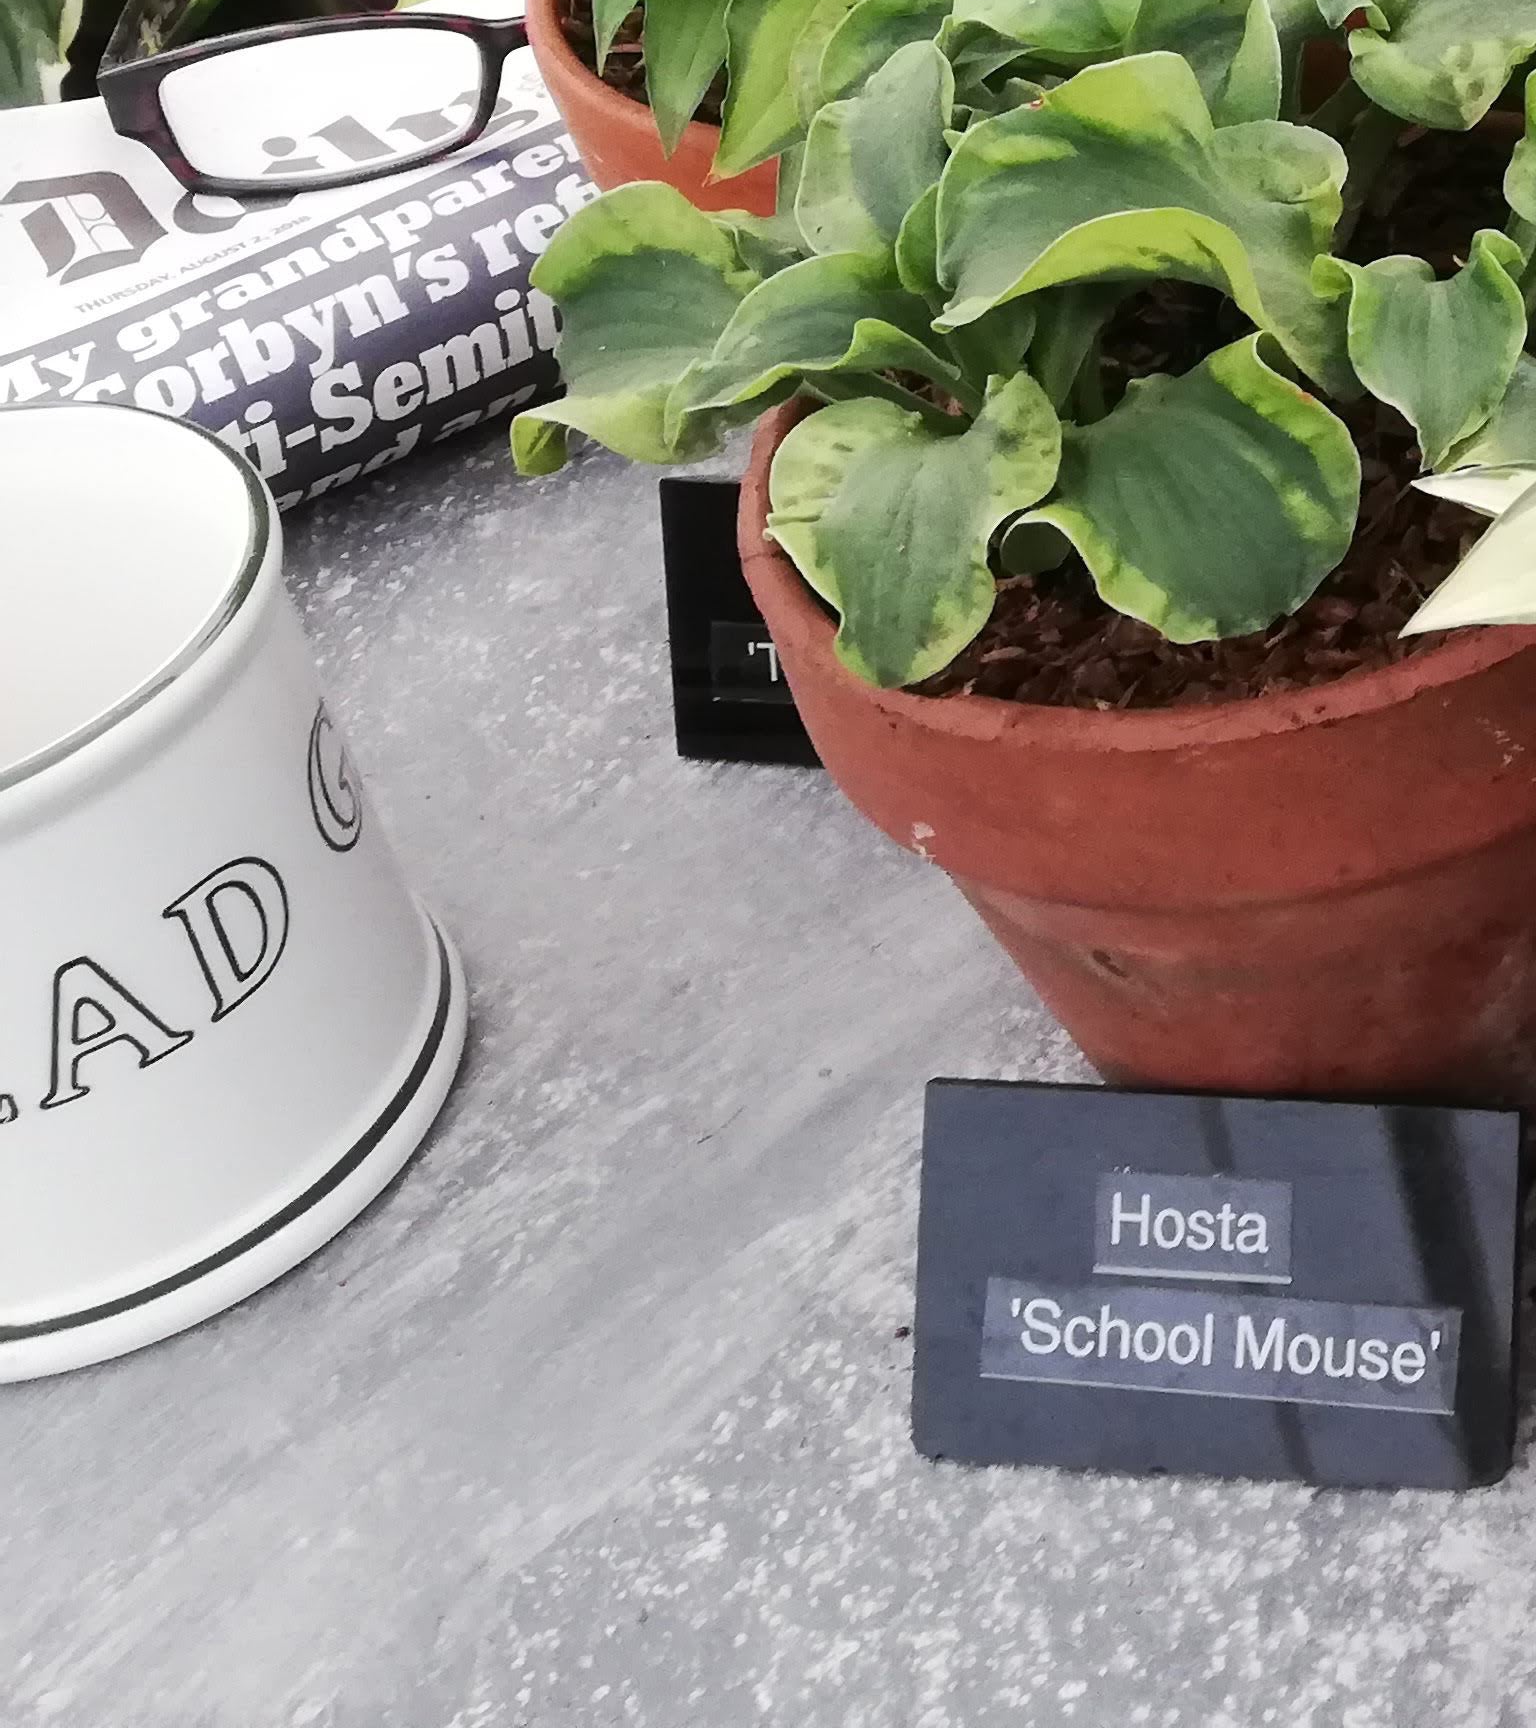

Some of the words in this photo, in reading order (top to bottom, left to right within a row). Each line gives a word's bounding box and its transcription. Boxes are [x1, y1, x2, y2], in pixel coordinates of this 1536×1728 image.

[180, 242, 248, 274] AUGUST
[0, 855, 289, 1124] AD
[1110, 1191, 1270, 1254] Hosta
[1010, 1297, 1214, 1367] 'School
[1233, 1312, 1442, 1384] Mouse'
